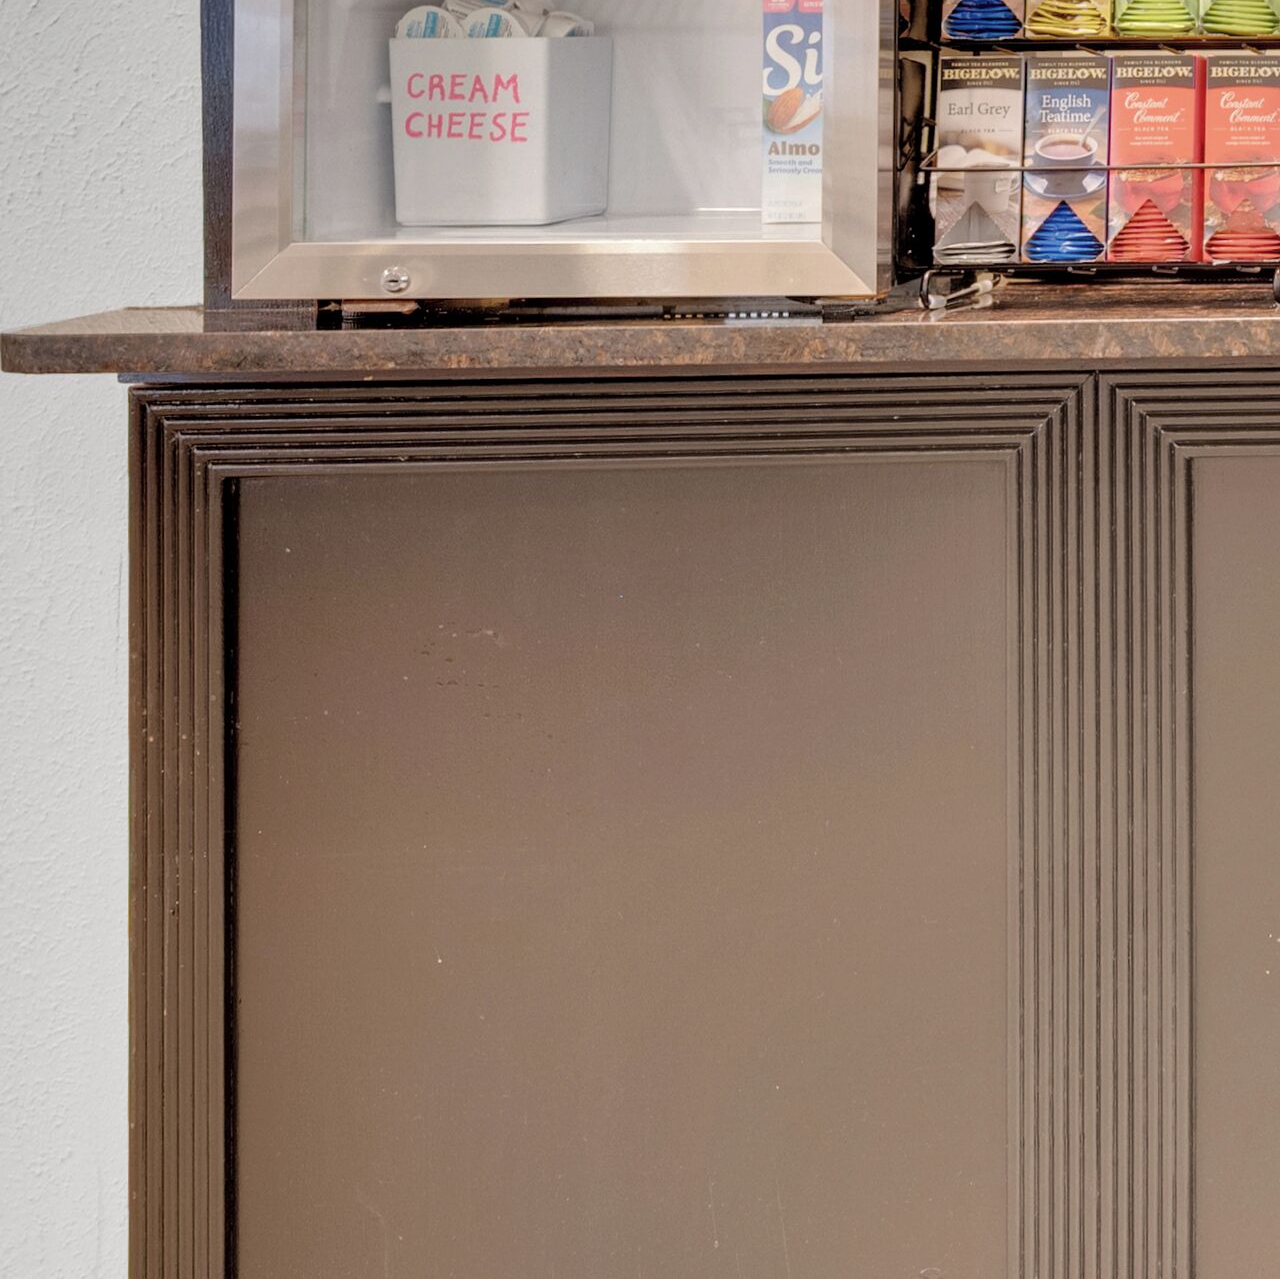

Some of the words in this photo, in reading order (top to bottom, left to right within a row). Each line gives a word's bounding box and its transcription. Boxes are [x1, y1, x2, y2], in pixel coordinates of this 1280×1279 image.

[942, 68, 1020, 80] BIGELOW
[1030, 68, 1107, 80] BIGELOW
[1116, 66, 1193, 78] BIGELOW
[407, 73, 521, 104] CREAM
[1042, 94, 1091, 111] English
[947, 103, 973, 116] Earl
[977, 103, 1010, 118] Grey
[1040, 110, 1094, 123] Teatime.
[405, 111, 530, 143] CHEESE
[768, 141, 820, 156] Almo
